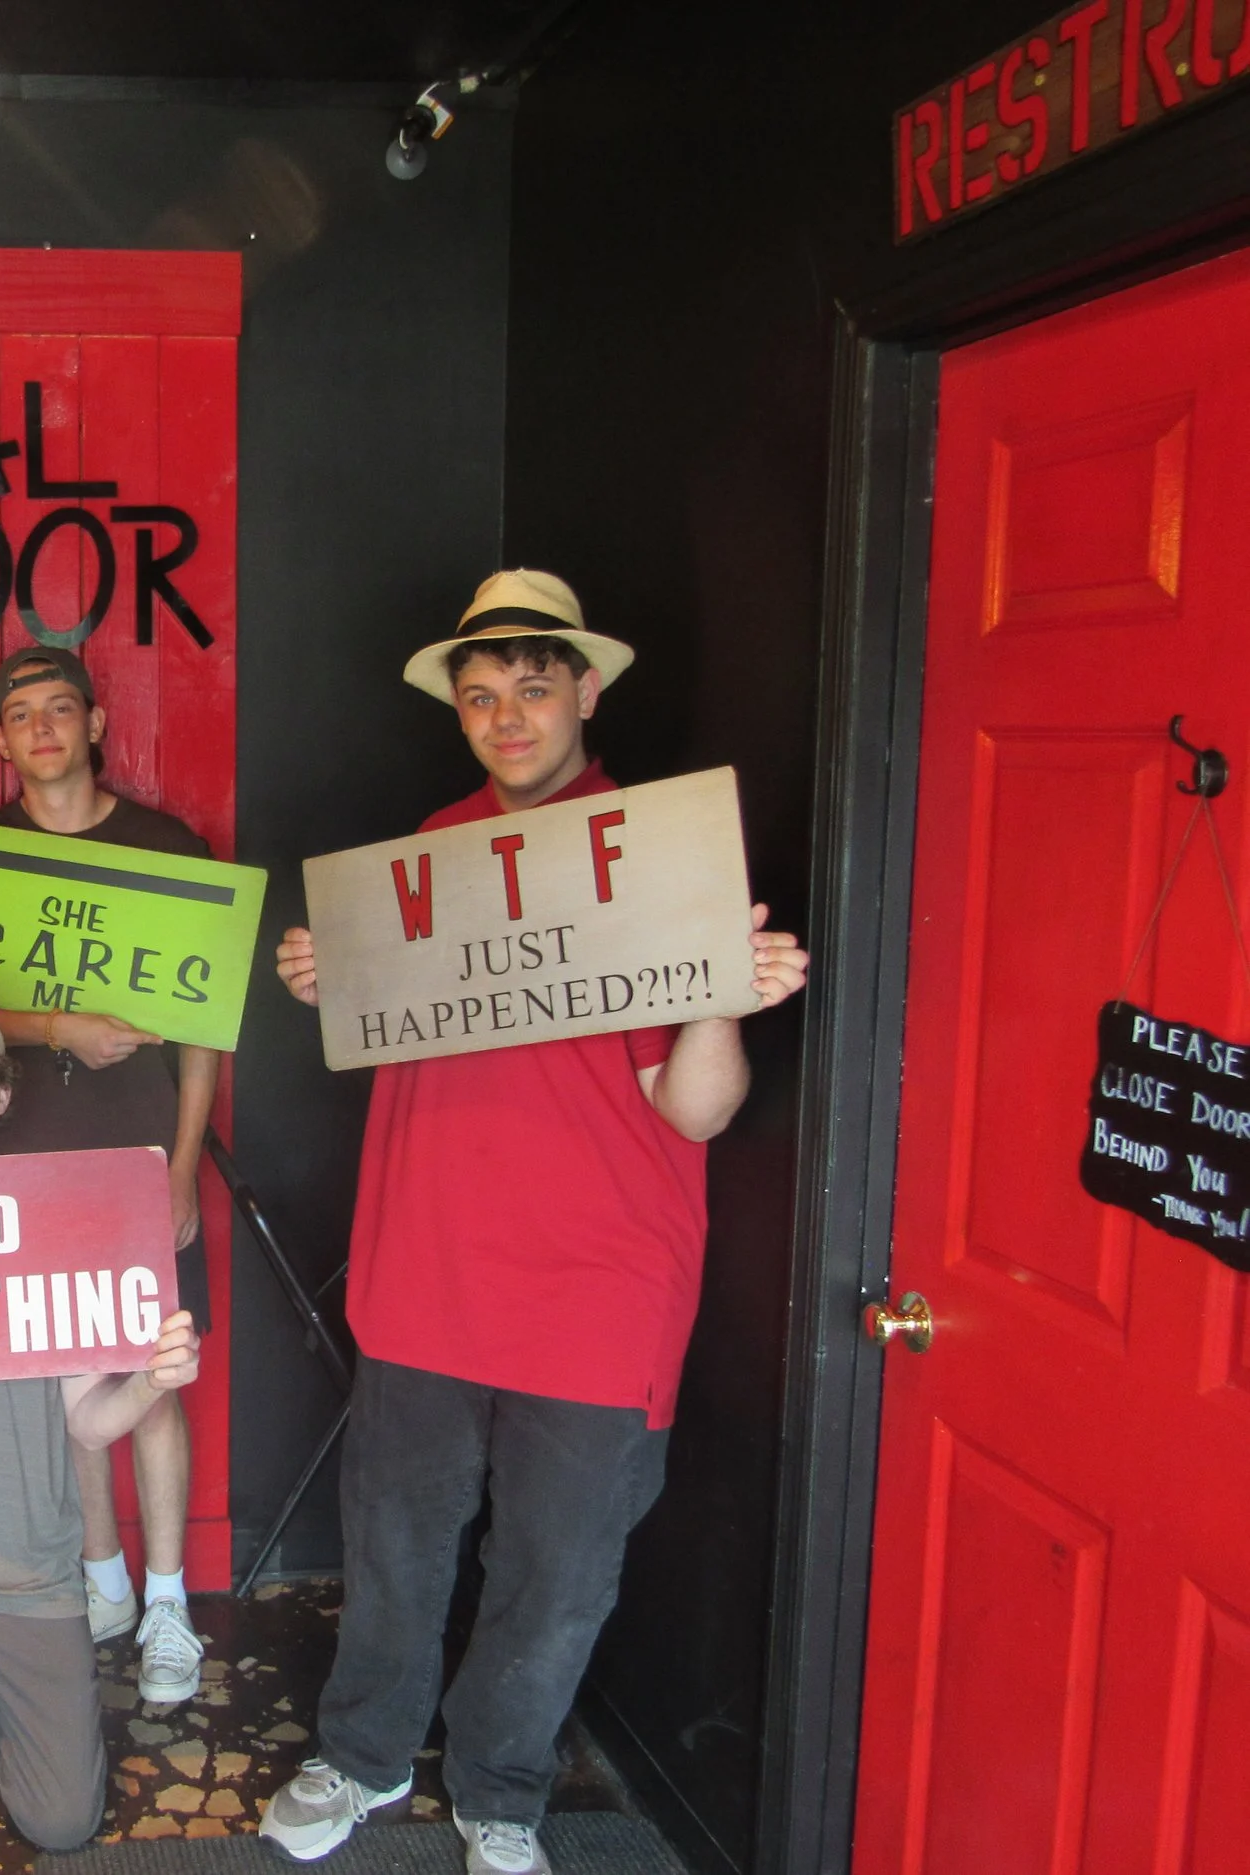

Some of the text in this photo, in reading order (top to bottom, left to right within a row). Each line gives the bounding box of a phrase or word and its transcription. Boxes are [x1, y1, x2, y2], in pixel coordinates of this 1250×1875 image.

[38, 895, 108, 933] SHE
[458, 923, 575, 982] JUST
[32, 980, 86, 1014] ME
[358, 958, 713, 1051] HAPPENED?!?!
[1131, 1014, 1247, 1080] PLEASE
[1101, 1063, 1250, 1139] CLOSE DOOR
[1093, 1117, 1168, 1172] BEHIND
